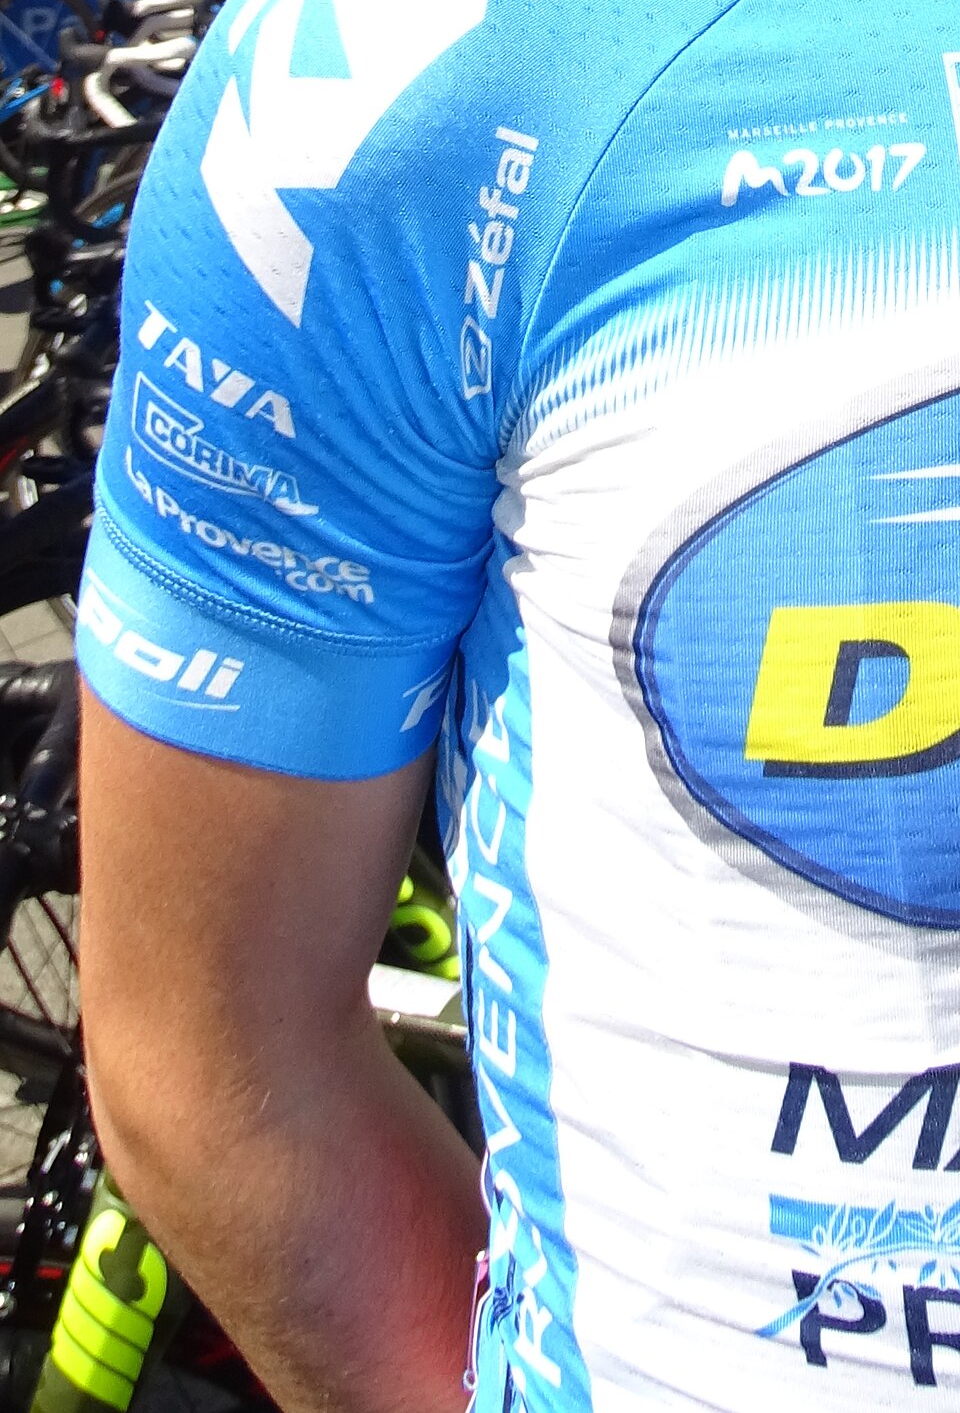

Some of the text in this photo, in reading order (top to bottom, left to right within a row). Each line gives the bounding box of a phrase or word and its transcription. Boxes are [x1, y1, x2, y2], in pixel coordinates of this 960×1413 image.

[727, 112, 908, 140] MARSEILLE PROVENCE
[464, 125, 539, 319] Zéfal
[137, 300, 297, 439] TAYA
